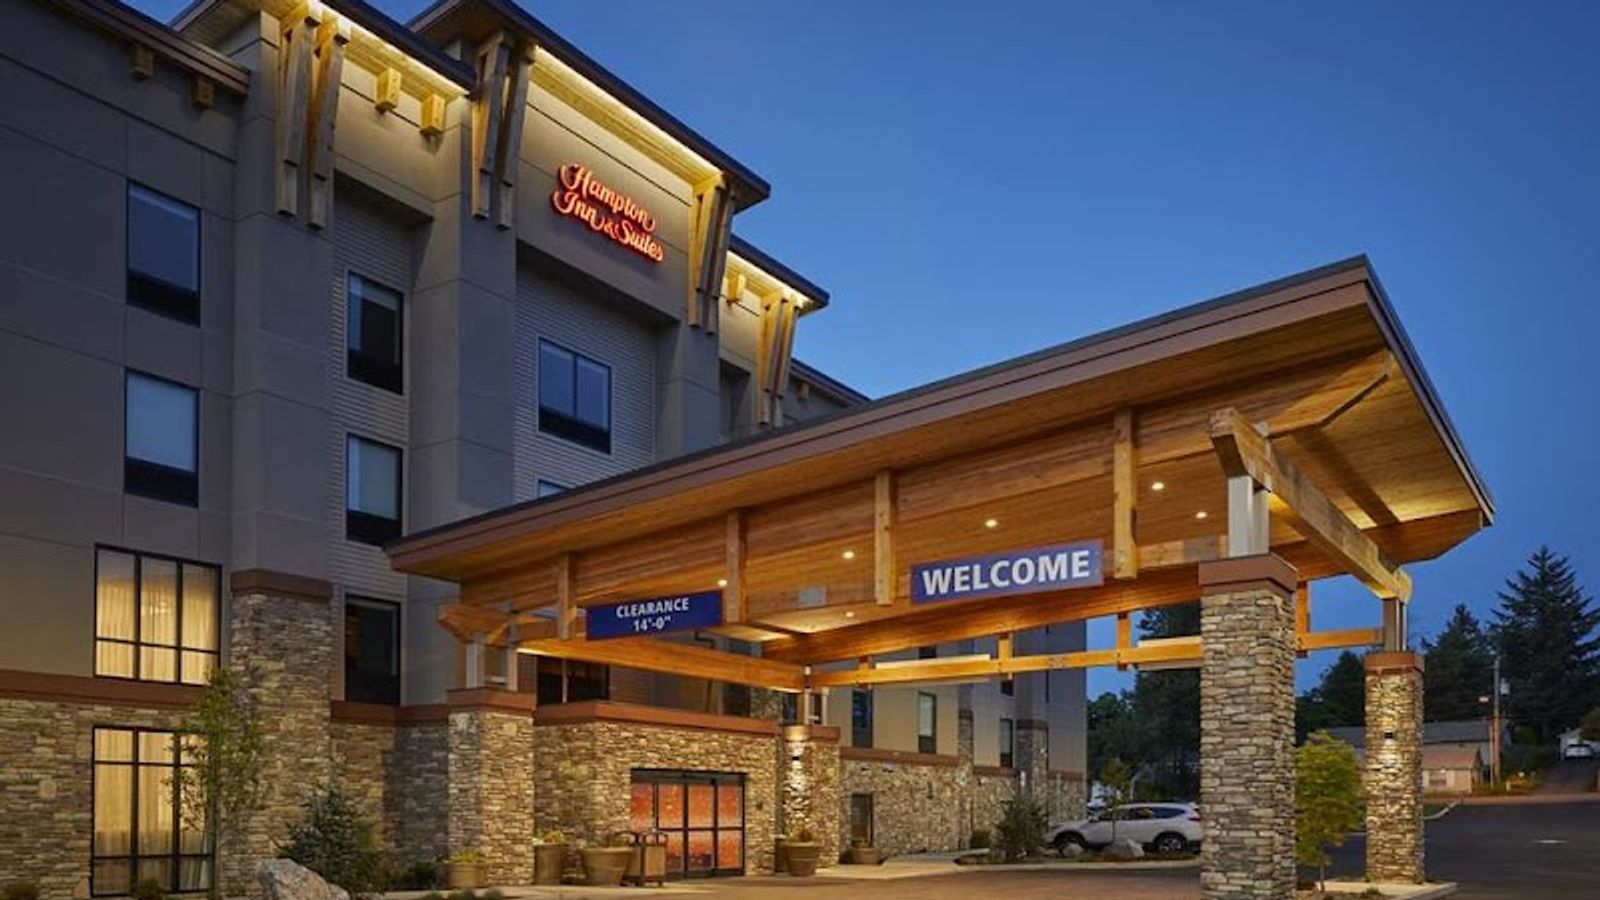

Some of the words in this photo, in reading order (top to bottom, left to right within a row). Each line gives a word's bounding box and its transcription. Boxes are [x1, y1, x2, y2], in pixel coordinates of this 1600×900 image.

[553, 190, 605, 230] Inn
[603, 219, 618, 240] &
[615, 220, 664, 261] Suites
[560, 163, 656, 232] Hampton
[922, 550, 1090, 595] WELCOME
[616, 598, 689, 617] CLEARANCE
